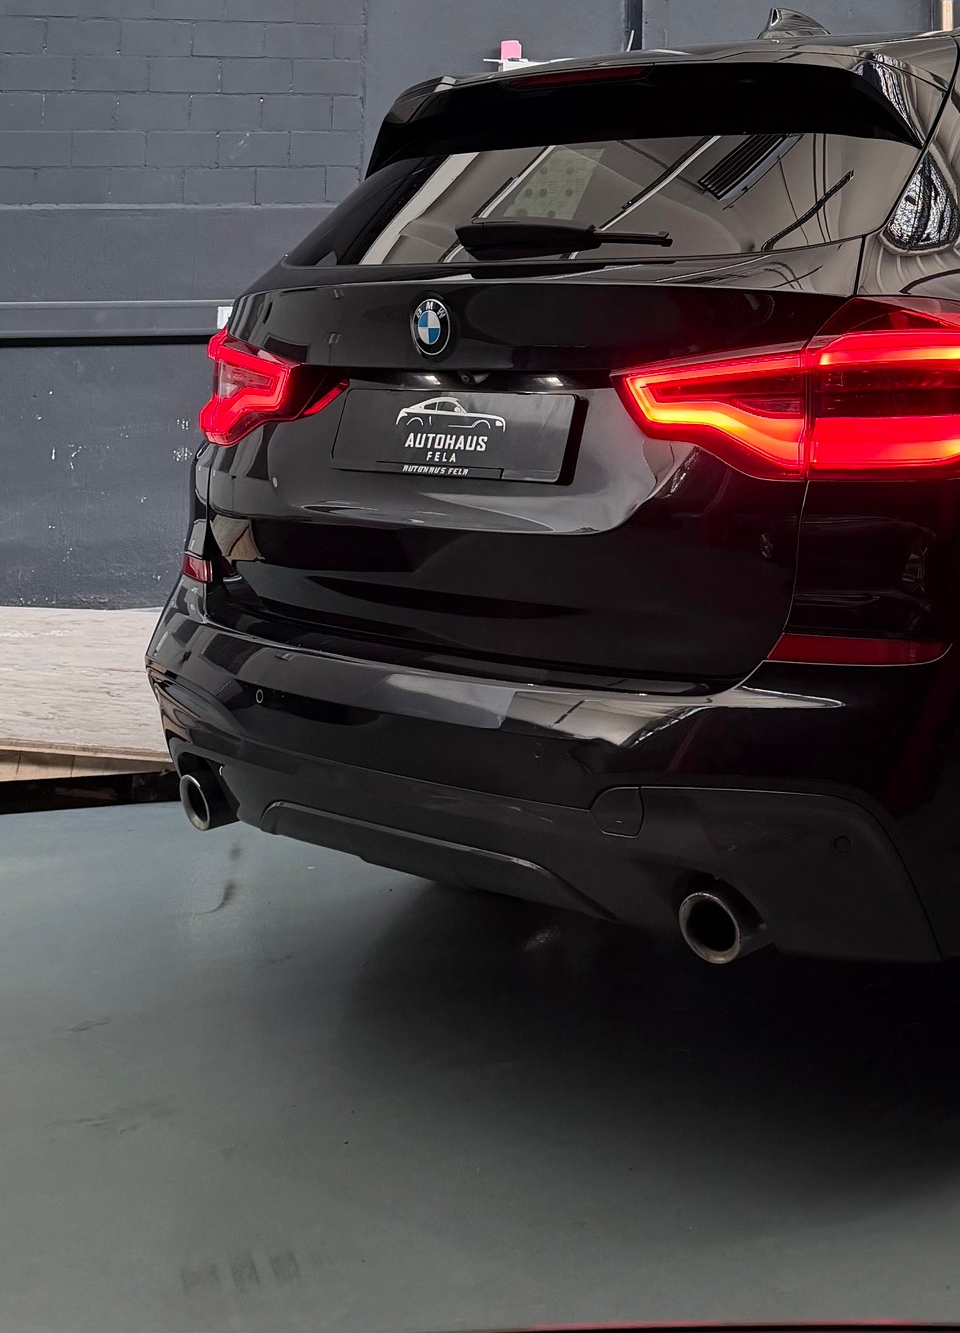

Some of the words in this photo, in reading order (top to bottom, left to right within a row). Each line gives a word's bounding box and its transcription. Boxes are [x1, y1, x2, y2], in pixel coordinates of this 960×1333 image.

[414, 301, 446, 319] BMW
[404, 432, 488, 451] AUTOHAUS
[426, 451, 456, 463] FELA
[402, 464, 447, 474] AUTOHAUS
[447, 467, 469, 476] FELA
